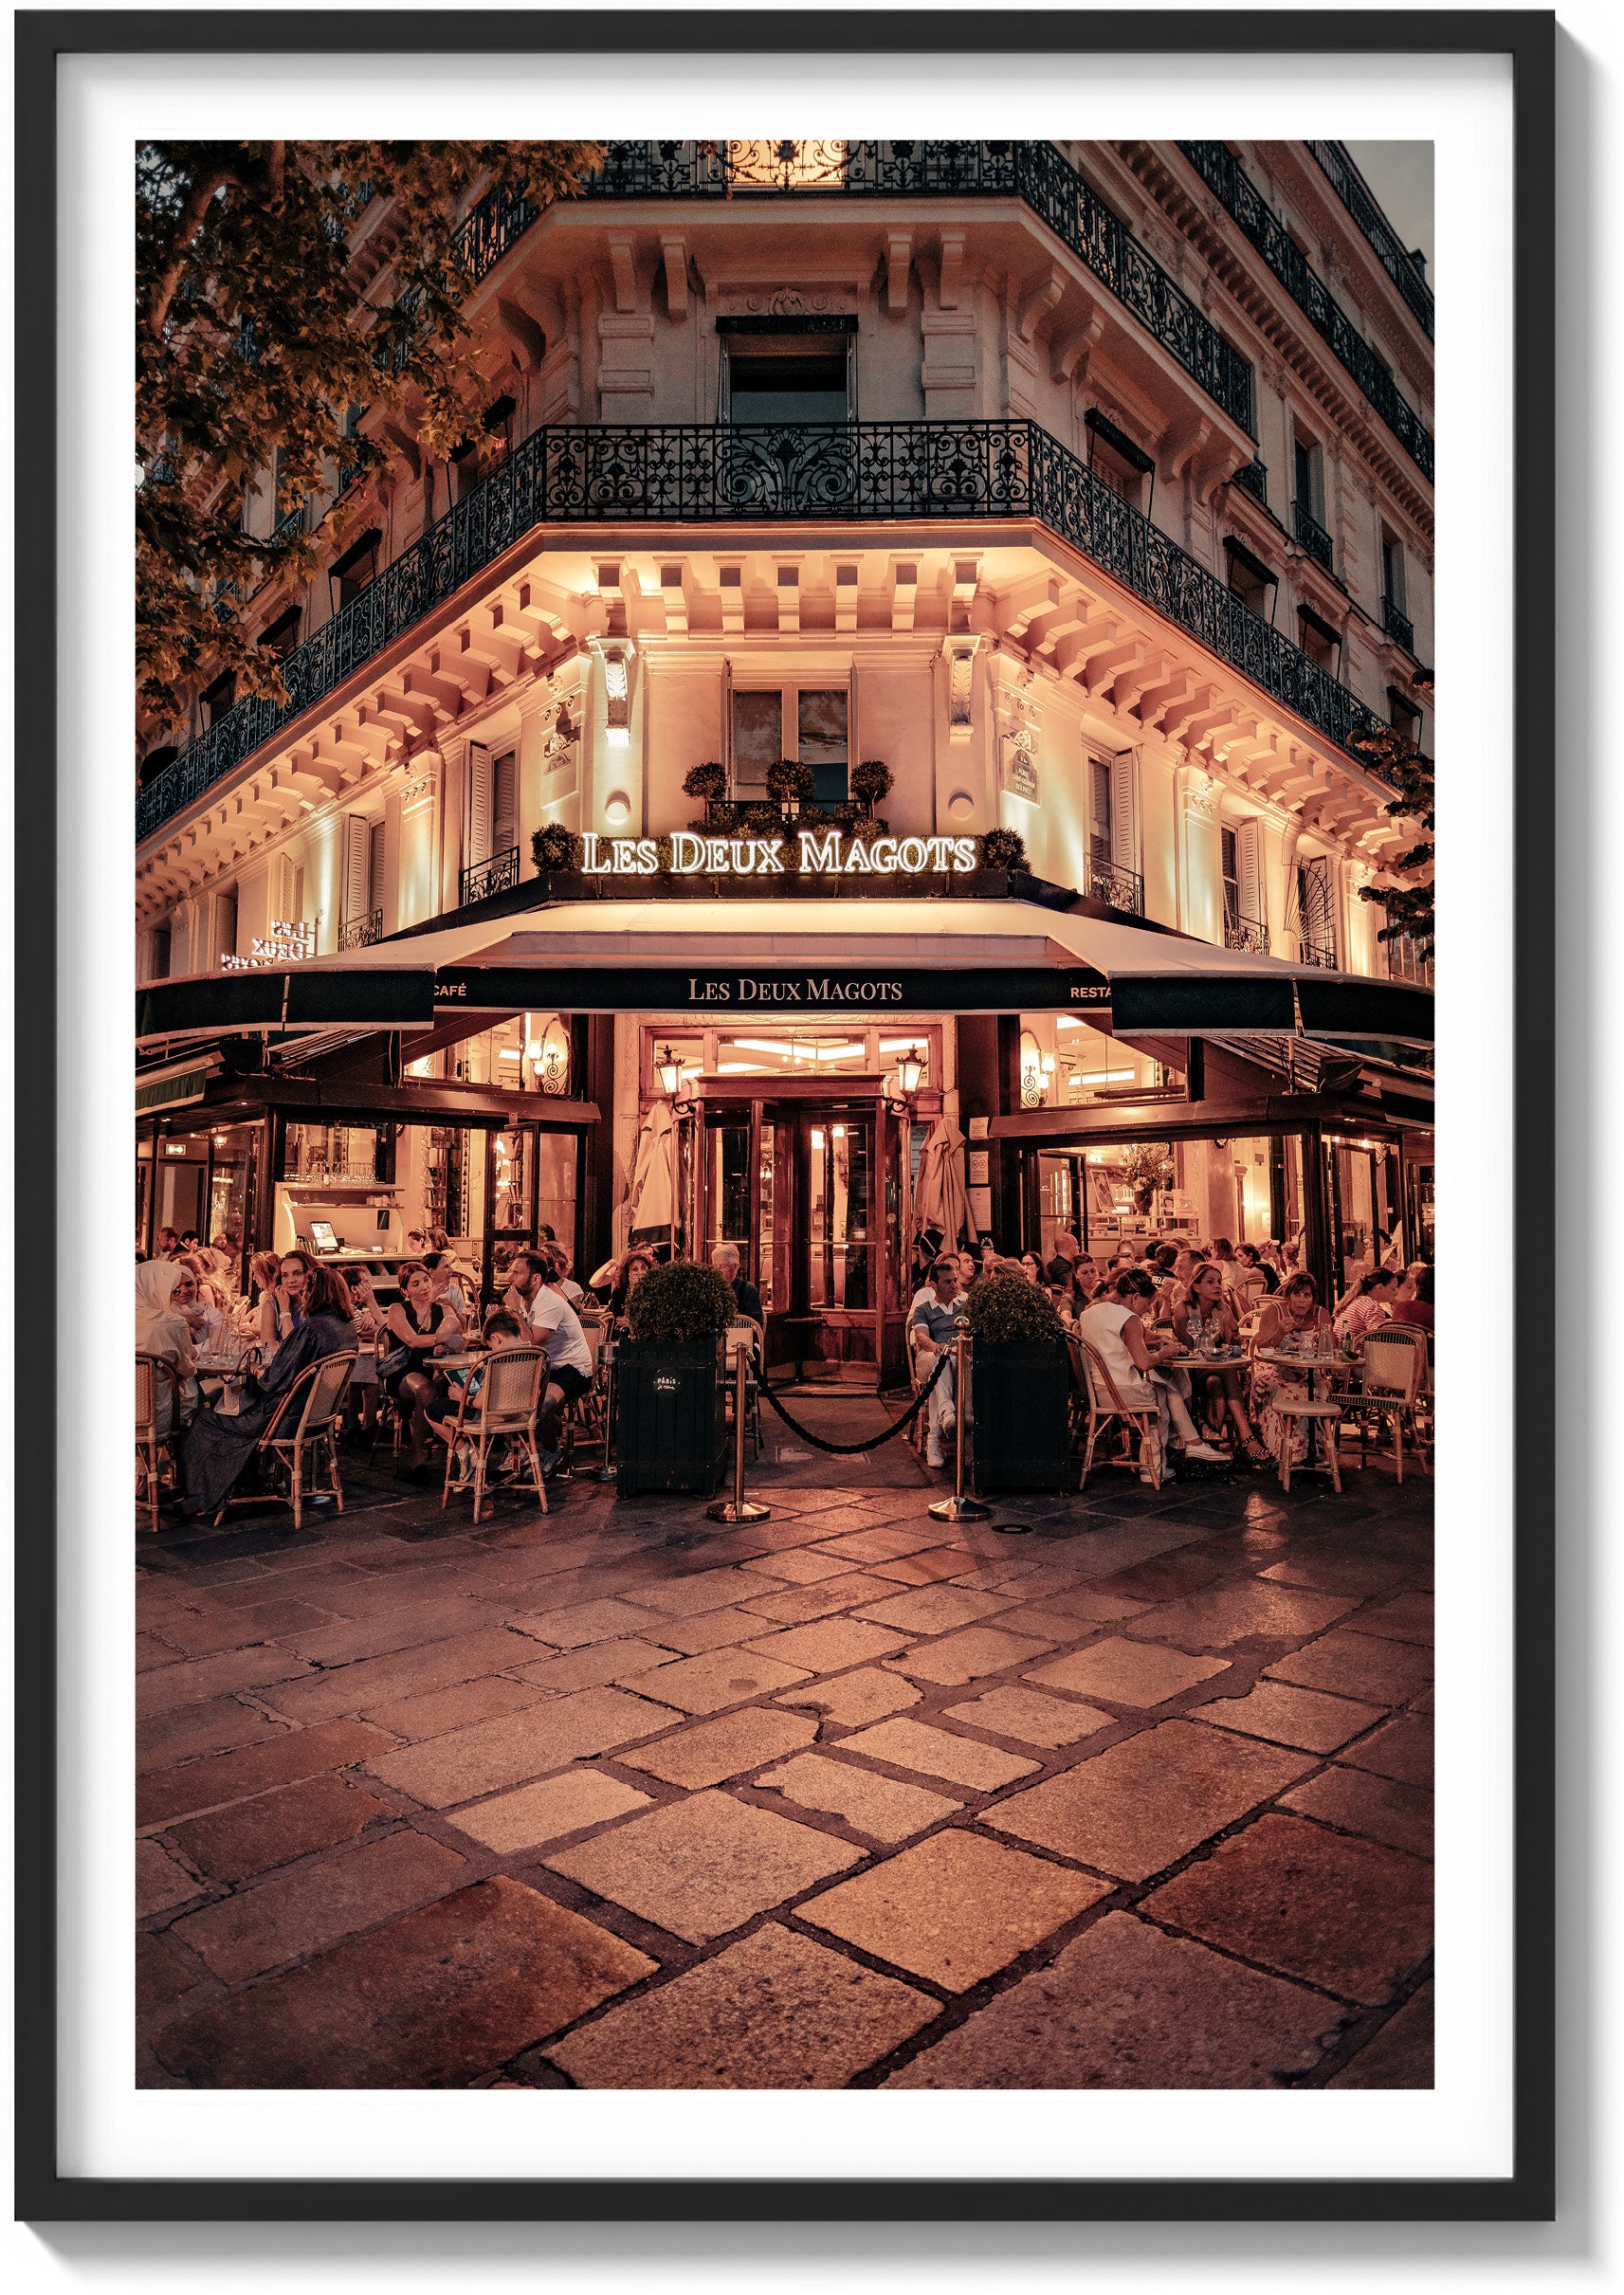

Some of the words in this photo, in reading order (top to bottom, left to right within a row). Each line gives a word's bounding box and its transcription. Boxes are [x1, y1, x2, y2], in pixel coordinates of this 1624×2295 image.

[581, 832, 658, 874] LES
[669, 831, 786, 874] DEUX
[797, 831, 977, 874] MAGOTS
[433, 982, 467, 996] CAFÉ
[688, 978, 731, 1001] LES
[738, 978, 802, 1001] DEUX
[806, 978, 903, 1001] MAGOTS
